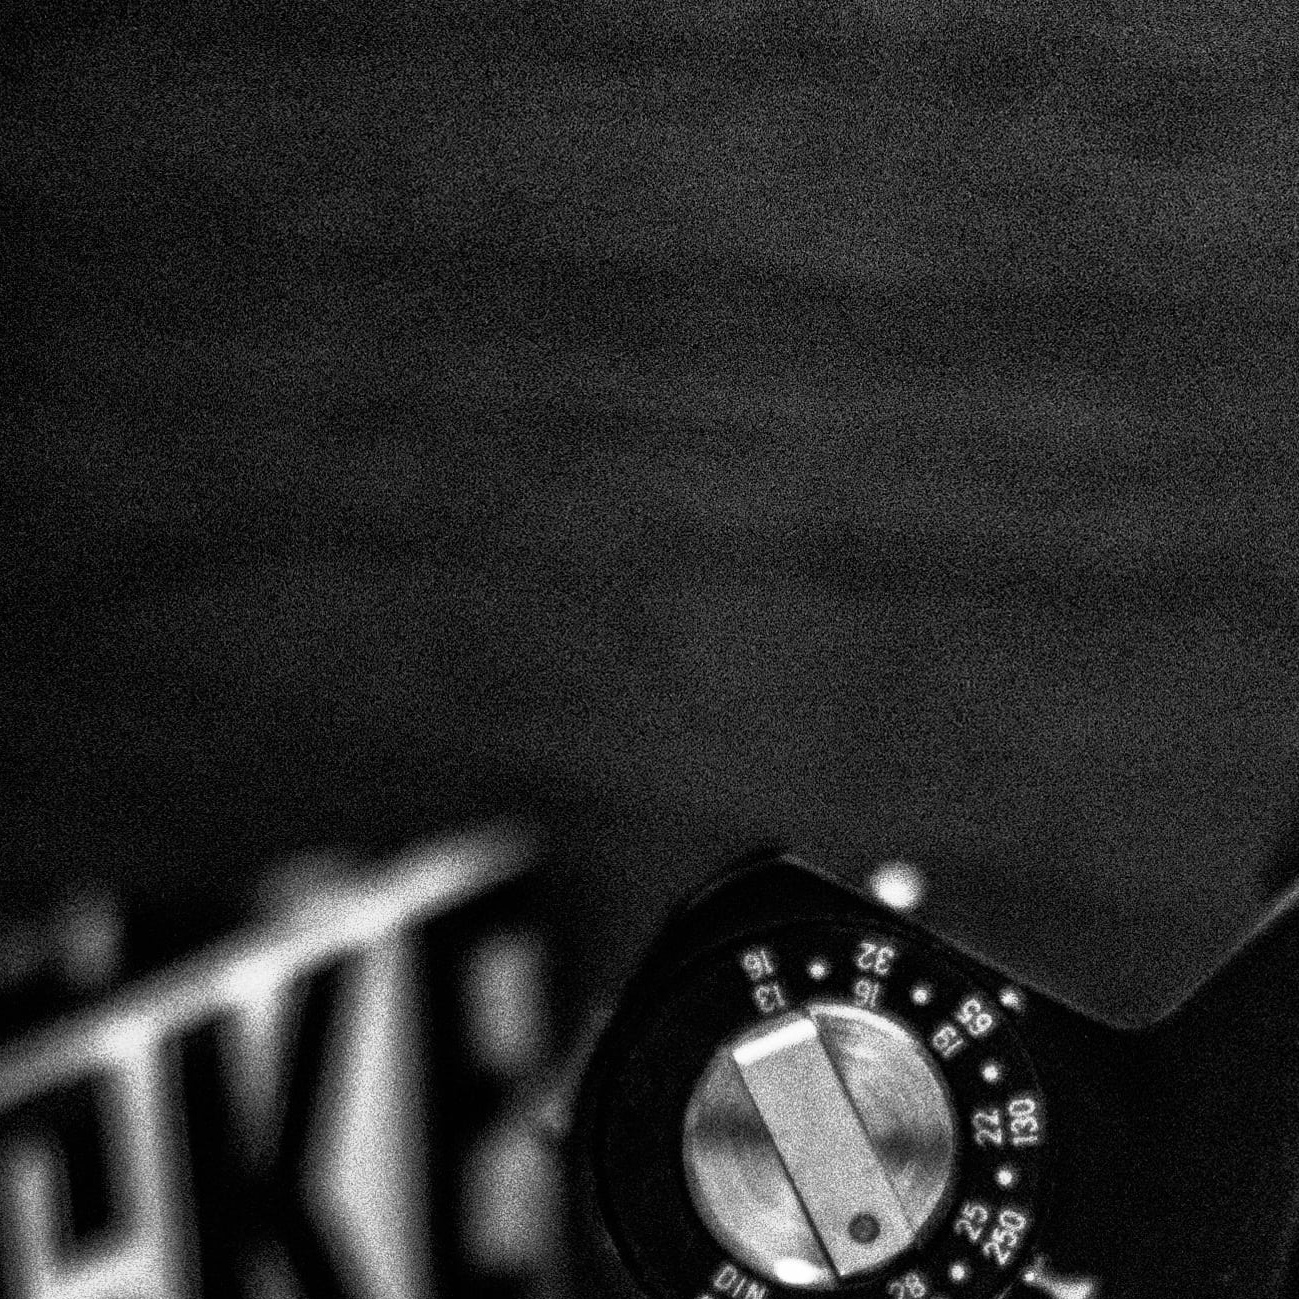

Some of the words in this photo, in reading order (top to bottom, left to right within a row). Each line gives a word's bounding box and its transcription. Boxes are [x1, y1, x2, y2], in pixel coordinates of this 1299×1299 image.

[742, 948, 774, 981] 16
[856, 942, 895, 975] 32
[754, 983, 786, 1012] 13
[854, 978, 881, 1008] 16
[957, 999, 994, 1037] 65
[932, 1025, 965, 1058] 19
[971, 1108, 1003, 1146] 22
[1008, 1098, 1039, 1146] 130
[954, 1203, 990, 1243] 25
[982, 1210, 1027, 1265] 250
